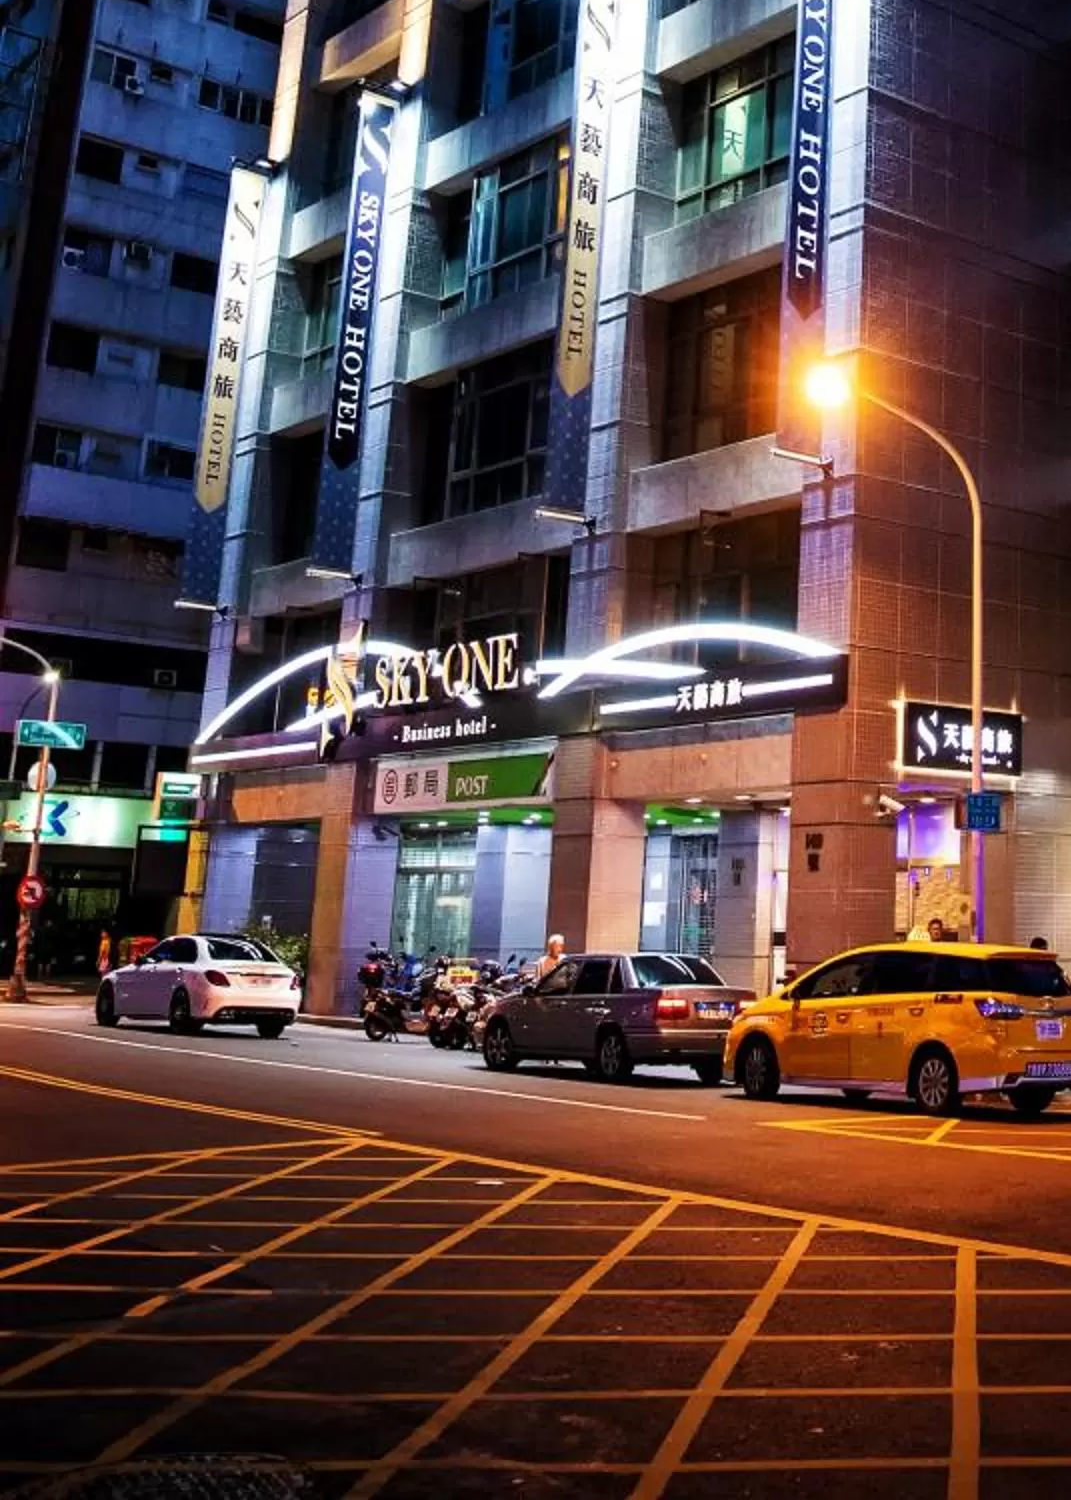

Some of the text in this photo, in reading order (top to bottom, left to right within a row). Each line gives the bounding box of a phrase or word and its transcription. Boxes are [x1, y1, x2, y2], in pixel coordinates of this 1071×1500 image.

[801, 34, 825, 114] ONE
[572, 74, 604, 254] 天藝商旅
[794, 137, 822, 282] HOTEL
[212, 260, 249, 400] 天藝商旅
[335, 190, 379, 442] SKY ONE HOTEL
[566, 270, 588, 362] HOTEL
[205, 413, 227, 486] HOTEL
[374, 632, 520, 708] SKY ONE
[401, 715, 488, 744] Business hotel
[454, 774, 490, 797] POST
